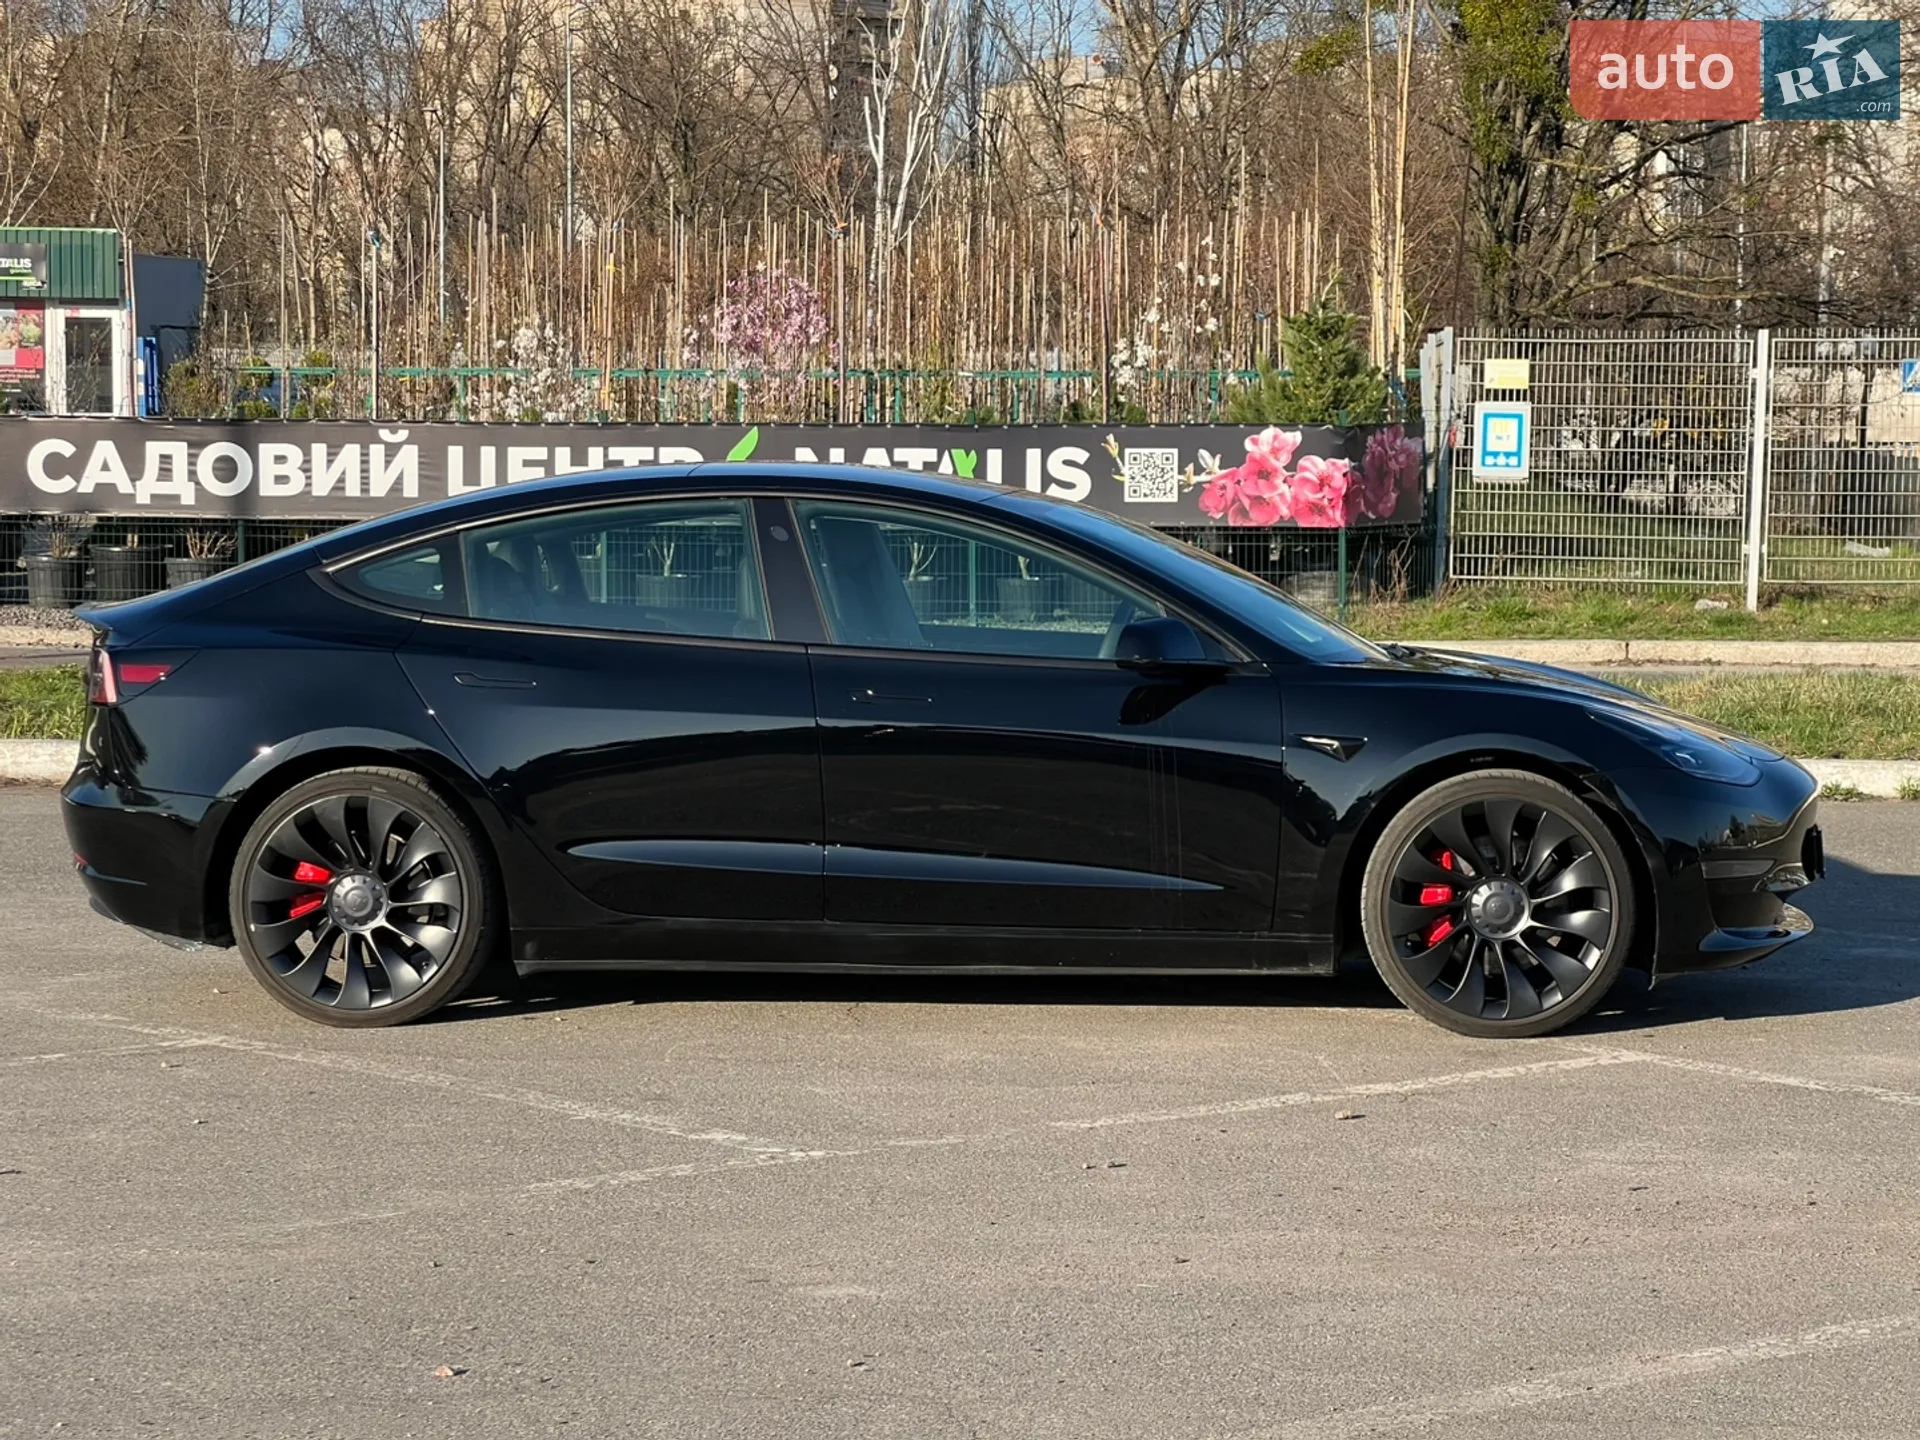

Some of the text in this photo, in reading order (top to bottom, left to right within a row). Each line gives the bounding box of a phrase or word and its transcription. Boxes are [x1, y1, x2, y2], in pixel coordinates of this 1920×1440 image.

[0, 257, 32, 268] TALIS
[26, 428, 419, 505] САДОВИЙ
[795, 446, 1092, 502] TALIS
